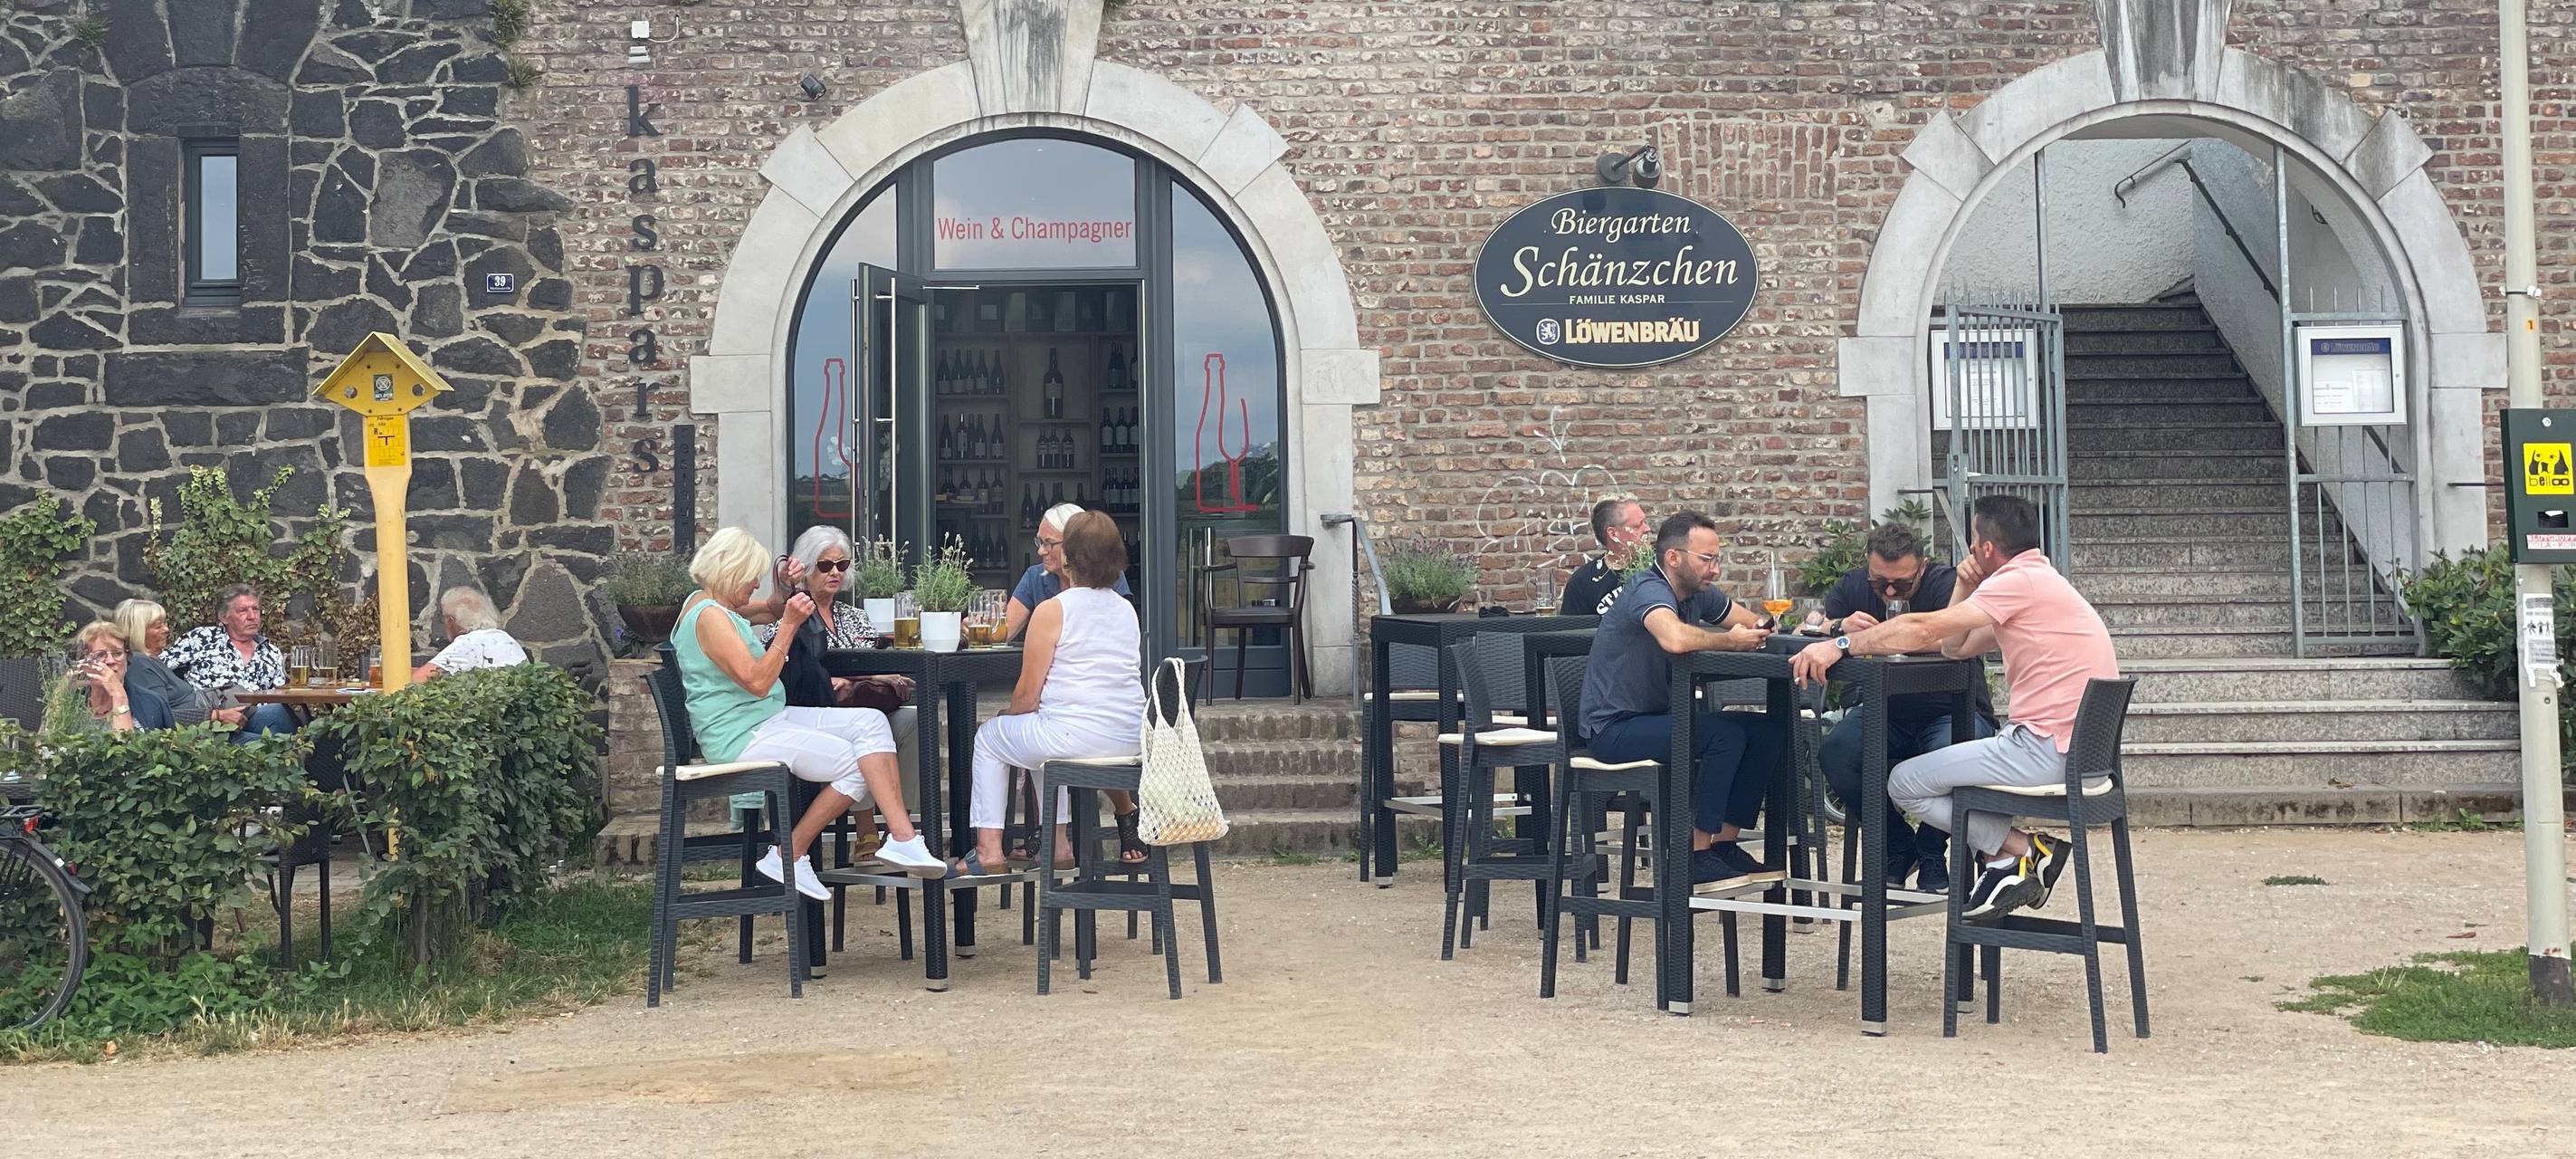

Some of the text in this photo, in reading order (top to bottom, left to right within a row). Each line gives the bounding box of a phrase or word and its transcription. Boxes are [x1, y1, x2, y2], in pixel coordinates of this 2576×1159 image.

[938, 216, 1132, 244] Wein & Champagner
[1550, 207, 1691, 244] Biergarten
[494, 275, 506, 287] 39
[624, 85, 665, 473] kaspars
[1500, 244, 1739, 298] Schänzchen
[1569, 294, 1665, 305] FAMILIE KASPAR
[1565, 317, 1701, 344] LÖWENBRÄU
